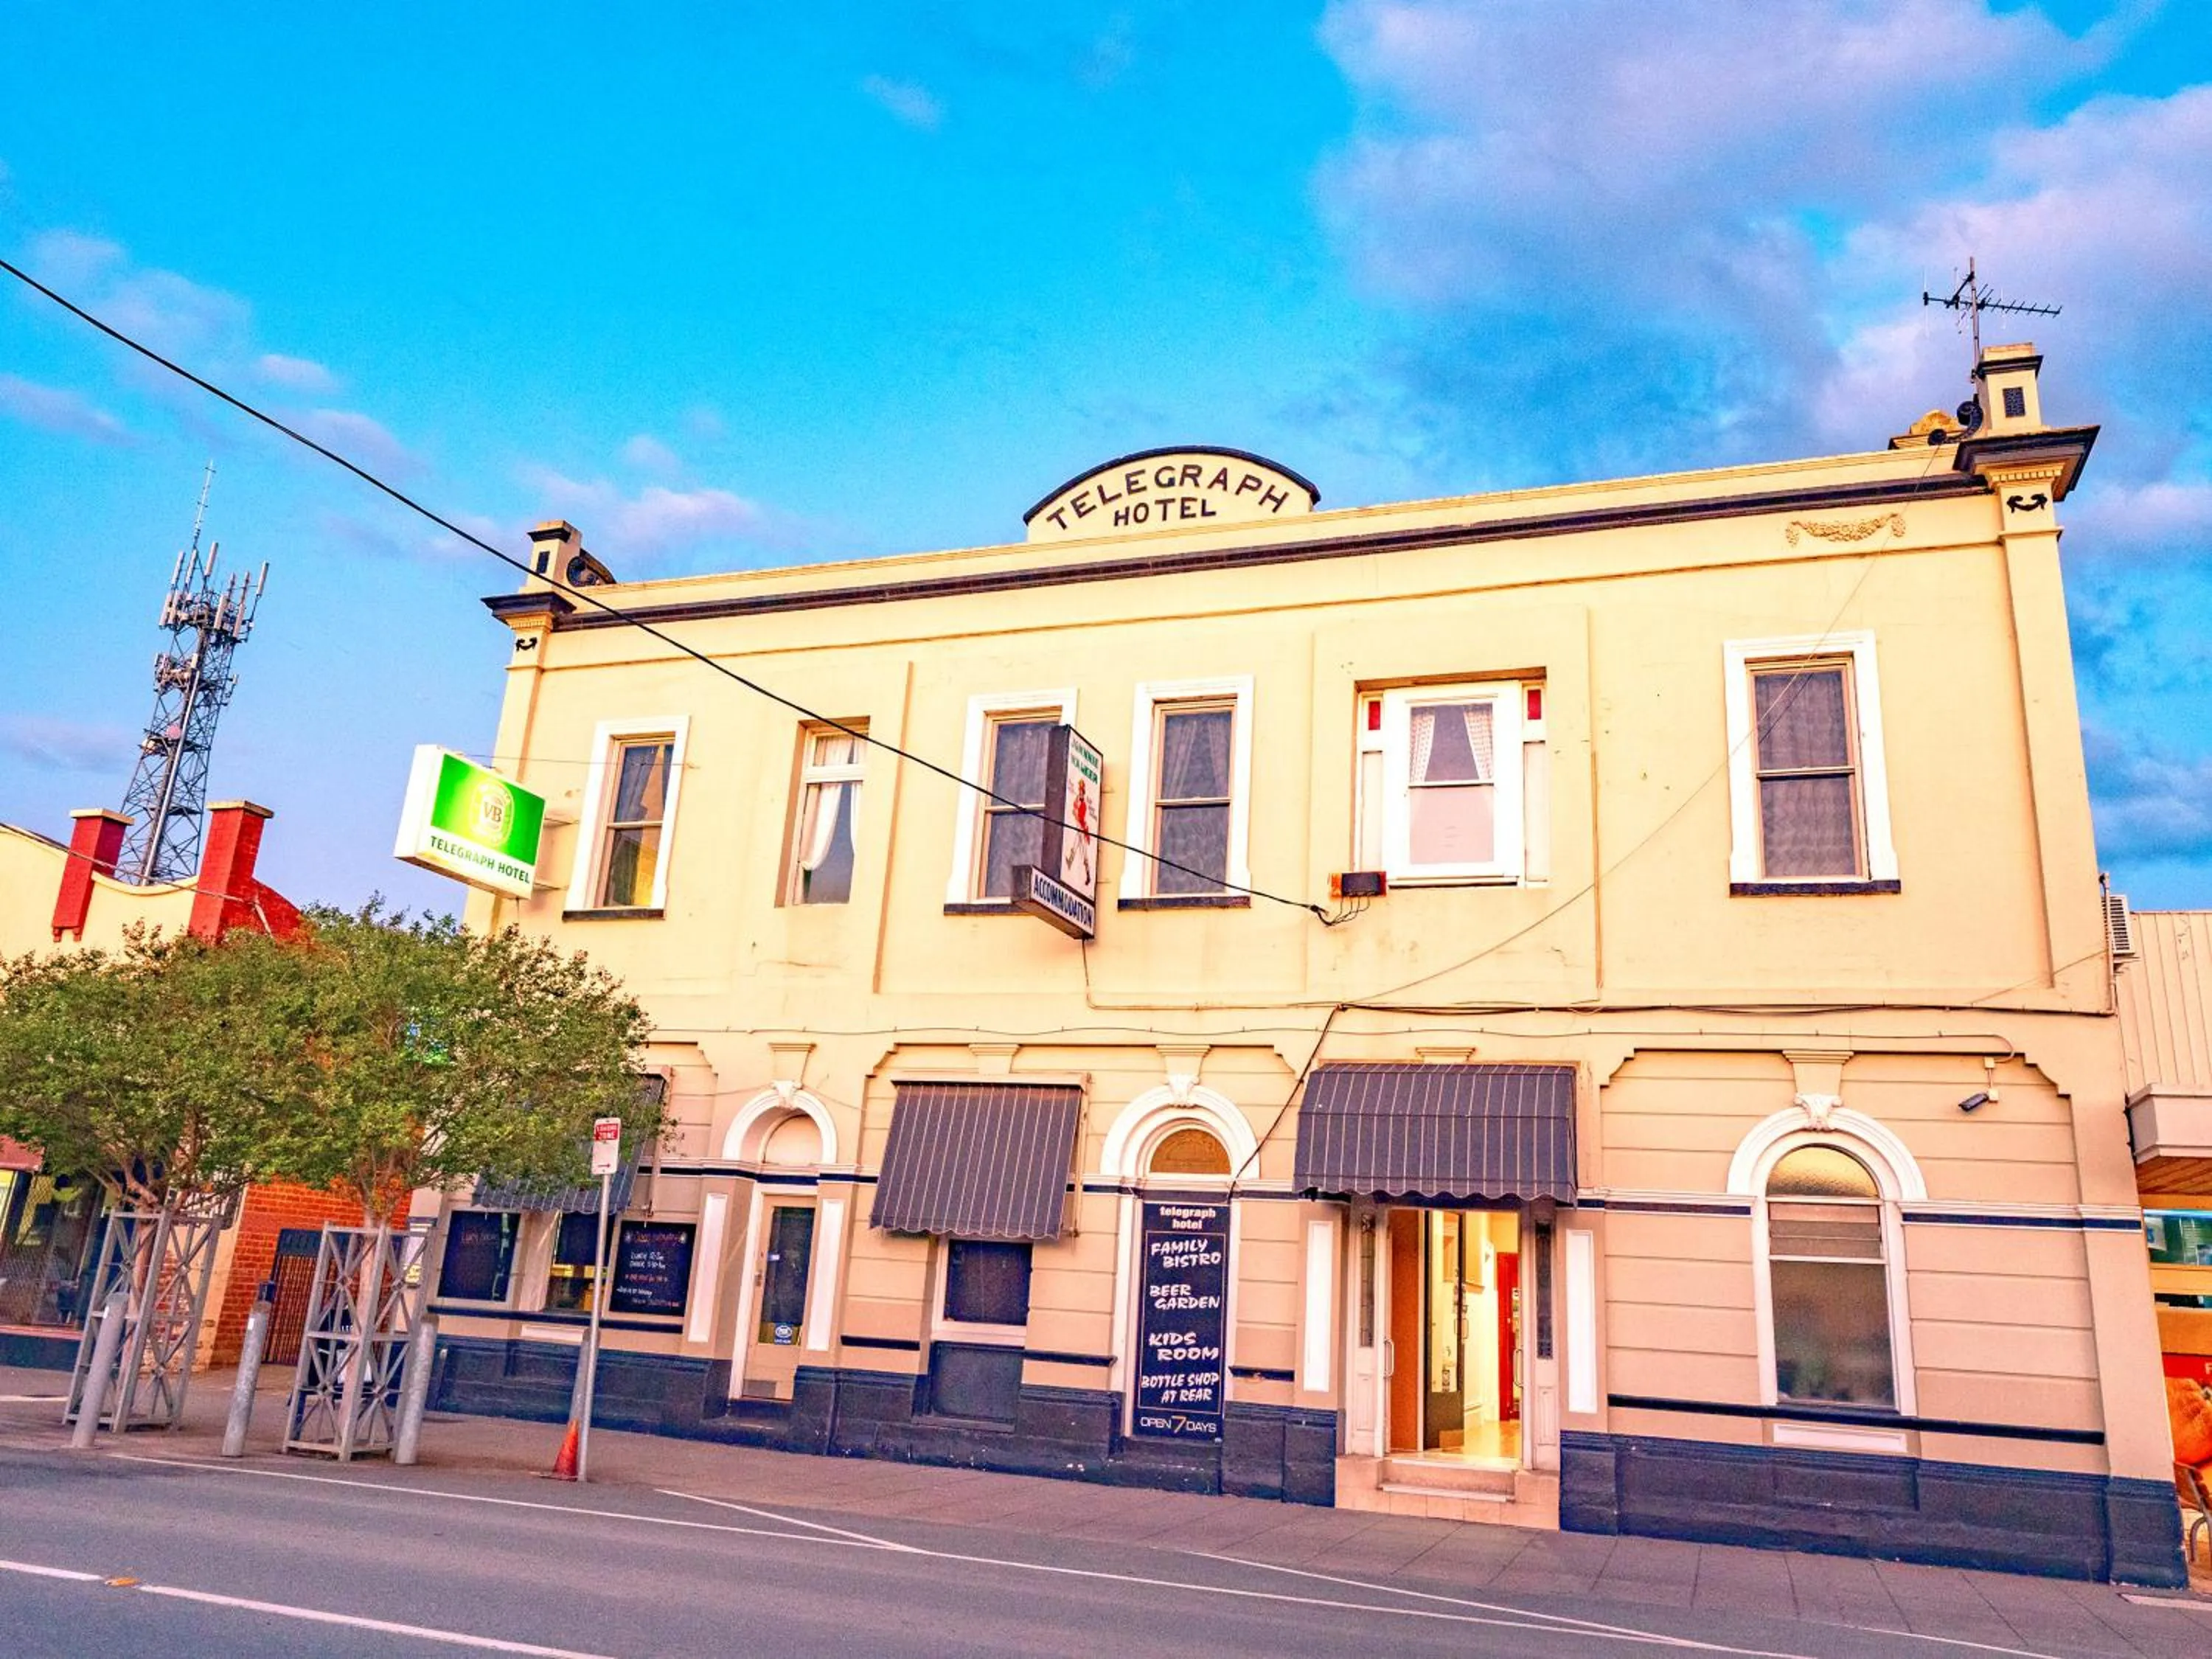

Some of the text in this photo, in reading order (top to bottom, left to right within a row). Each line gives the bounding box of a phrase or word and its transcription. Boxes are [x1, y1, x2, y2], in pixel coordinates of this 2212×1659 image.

[1046, 464, 1290, 531] TELEGRAPH
[1113, 497, 1217, 527] HOTEL
[484, 801, 503, 824] VB
[430, 835, 530, 884] TELEGRAPH HOTEL
[1033, 872, 1093, 927] ACCOMMODATION
[1160, 1206, 1216, 1220] telegraph
[1172, 1218, 1203, 1230] hotel
[1151, 1239, 1208, 1256] FAMILY
[1163, 1251, 1222, 1268] BISTRO
[1150, 1284, 1192, 1297] BEER
[1154, 1295, 1220, 1310] GARDEN
[1149, 1331, 1197, 1346] KIDS
[1157, 1346, 1220, 1362] ROOM
[1141, 1372, 1219, 1388] BOTTLE SHOP
[1161, 1388, 1213, 1404] AT REAR
[1140, 1415, 1217, 1433] OPEN 7 DAYS
